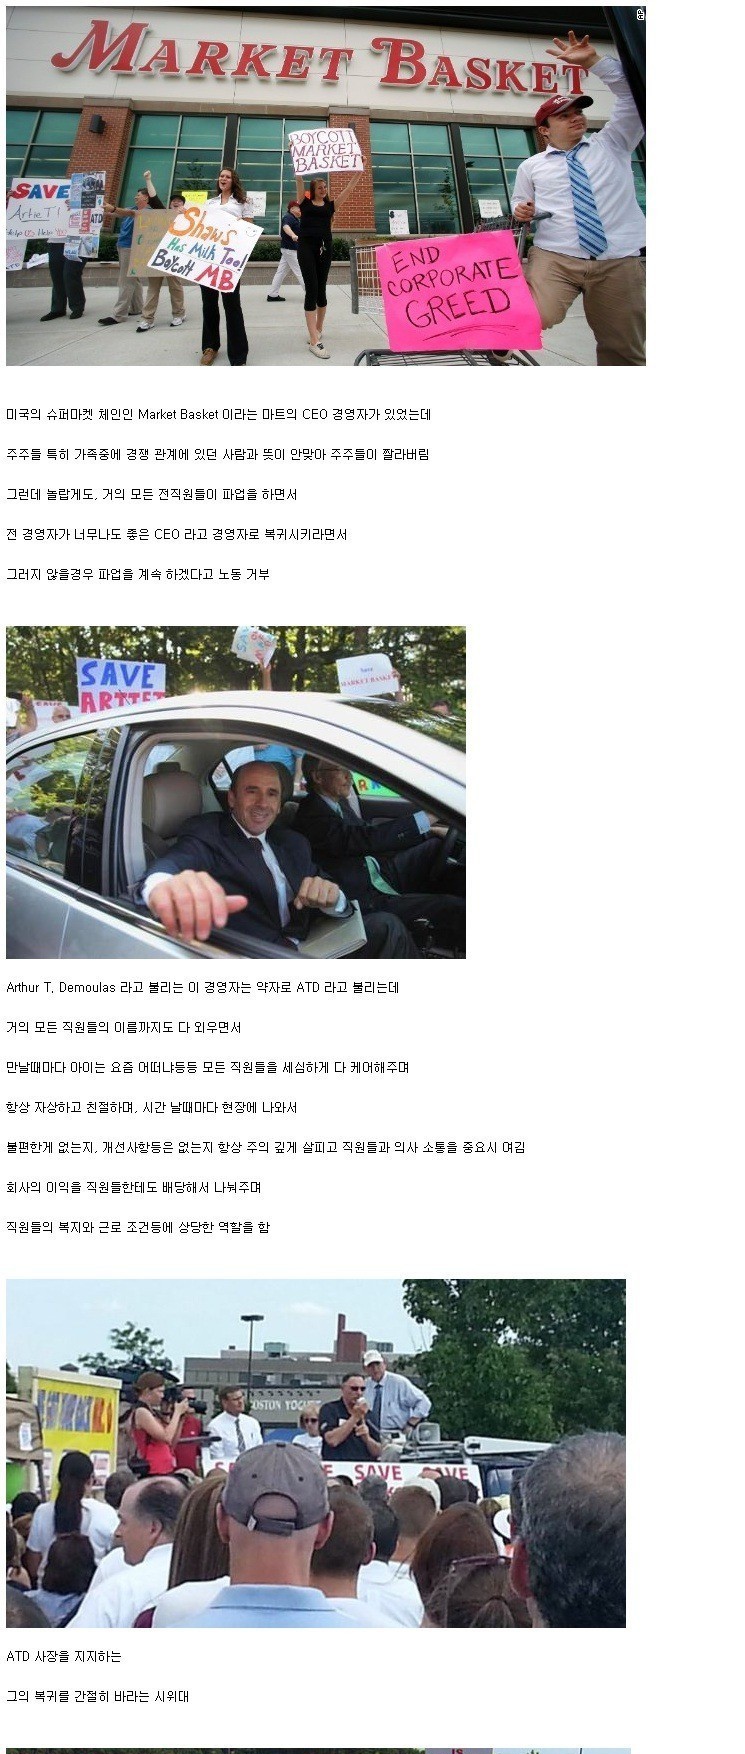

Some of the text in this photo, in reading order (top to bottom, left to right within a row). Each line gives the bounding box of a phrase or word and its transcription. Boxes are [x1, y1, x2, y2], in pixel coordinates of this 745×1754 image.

[51, 20, 589, 95] MARKET BASKET
[291, 129, 356, 145] BOYCOTT
[292, 142, 357, 157] MARKET
[296, 154, 361, 173] BASKET
[11, 183, 70, 199] SAVE
[167, 237, 249, 272] Has Milk Too!
[391, 246, 440, 274] END
[151, 249, 236, 292] Boycott MB
[387, 257, 518, 297] CORPORATE
[405, 287, 511, 328] GREED
[81, 660, 155, 689] SAVE
[355, 1465, 402, 1480] SAVE
